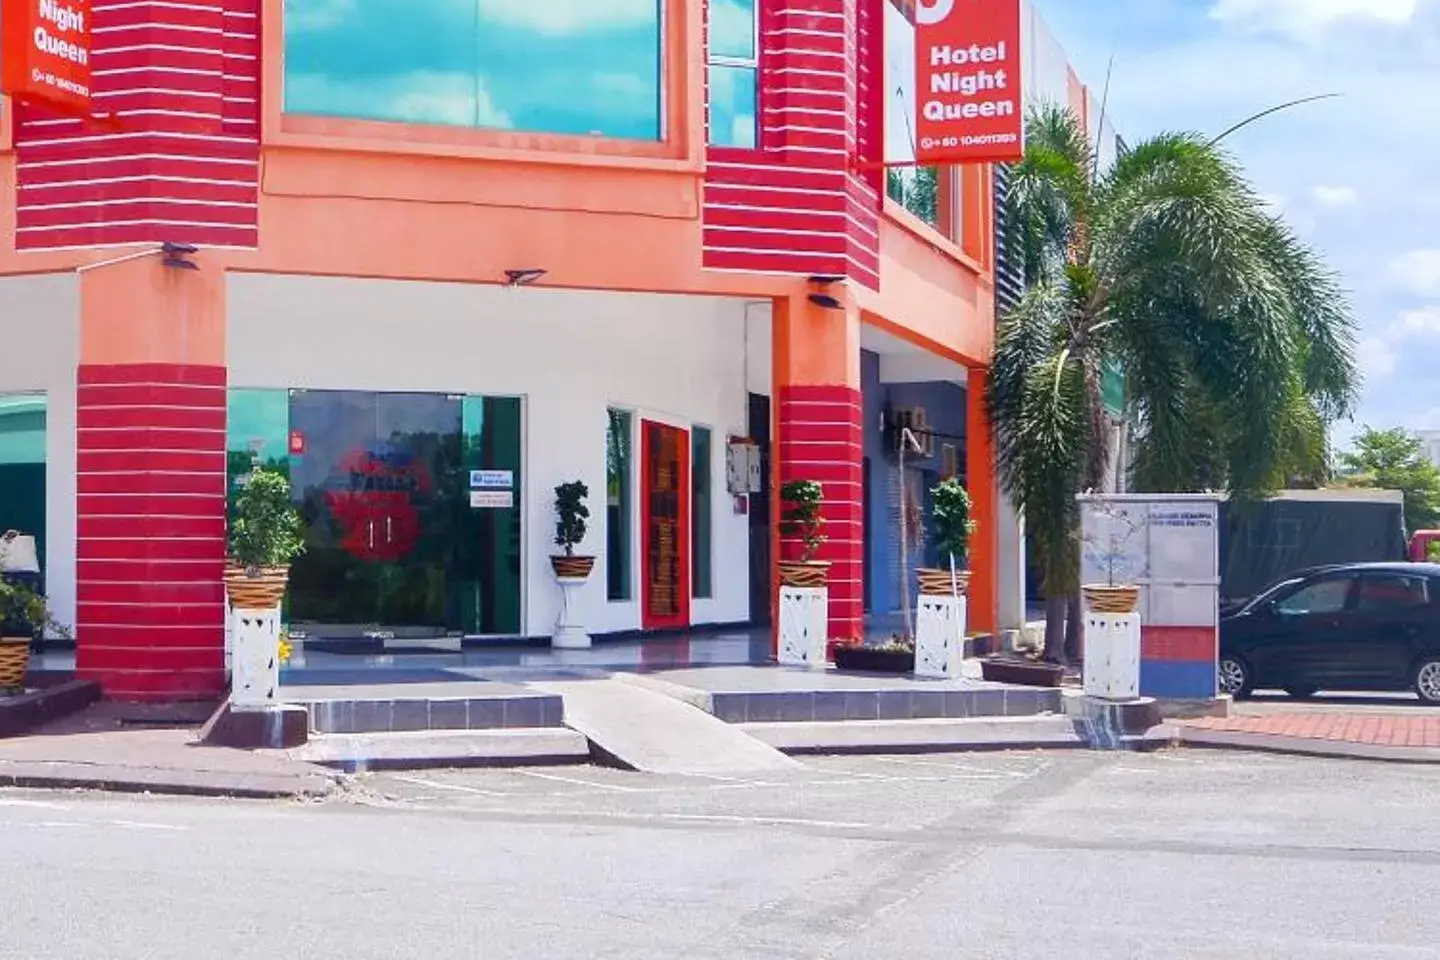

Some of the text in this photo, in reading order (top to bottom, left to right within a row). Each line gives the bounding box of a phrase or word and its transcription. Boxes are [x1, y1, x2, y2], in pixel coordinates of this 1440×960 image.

[33, 26, 88, 66] Queen
[930, 40, 1006, 66] Hotel
[930, 69, 1007, 96] Night
[923, 100, 1013, 121] Queen
